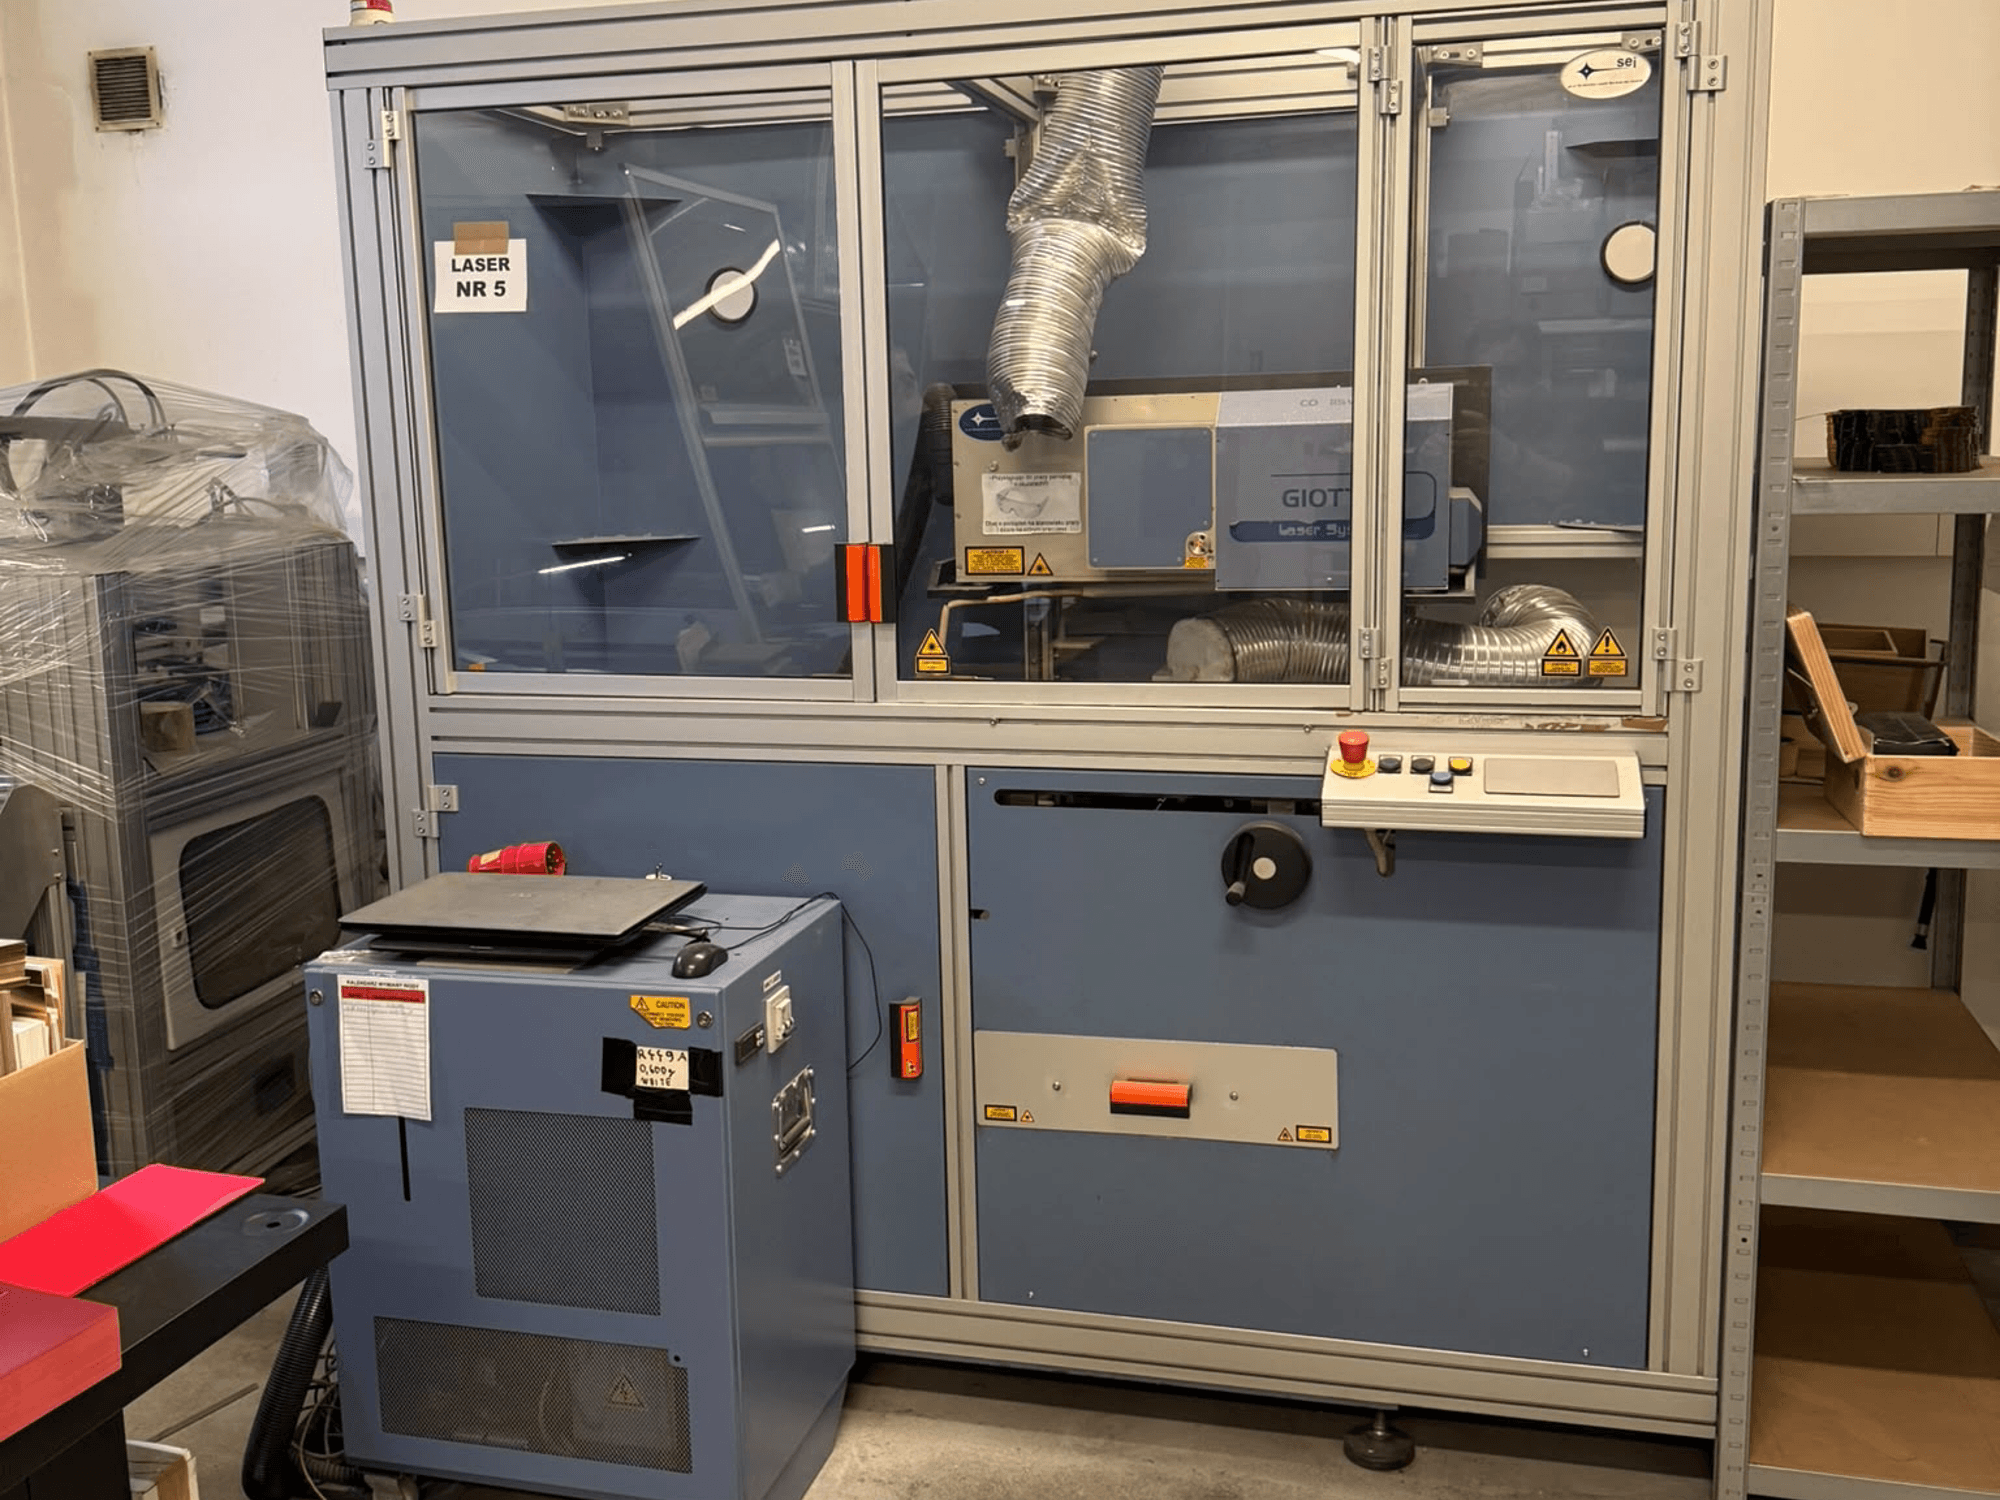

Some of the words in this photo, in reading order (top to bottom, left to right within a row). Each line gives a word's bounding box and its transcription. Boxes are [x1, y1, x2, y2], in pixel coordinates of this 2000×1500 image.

[451, 257, 510, 273] LASER
[456, 281, 487, 297] NR
[494, 280, 506, 297] 5
[1279, 524, 1321, 536] Laser
[1326, 524, 1350, 538] Sy
[656, 1000, 686, 1009] CAUTION
